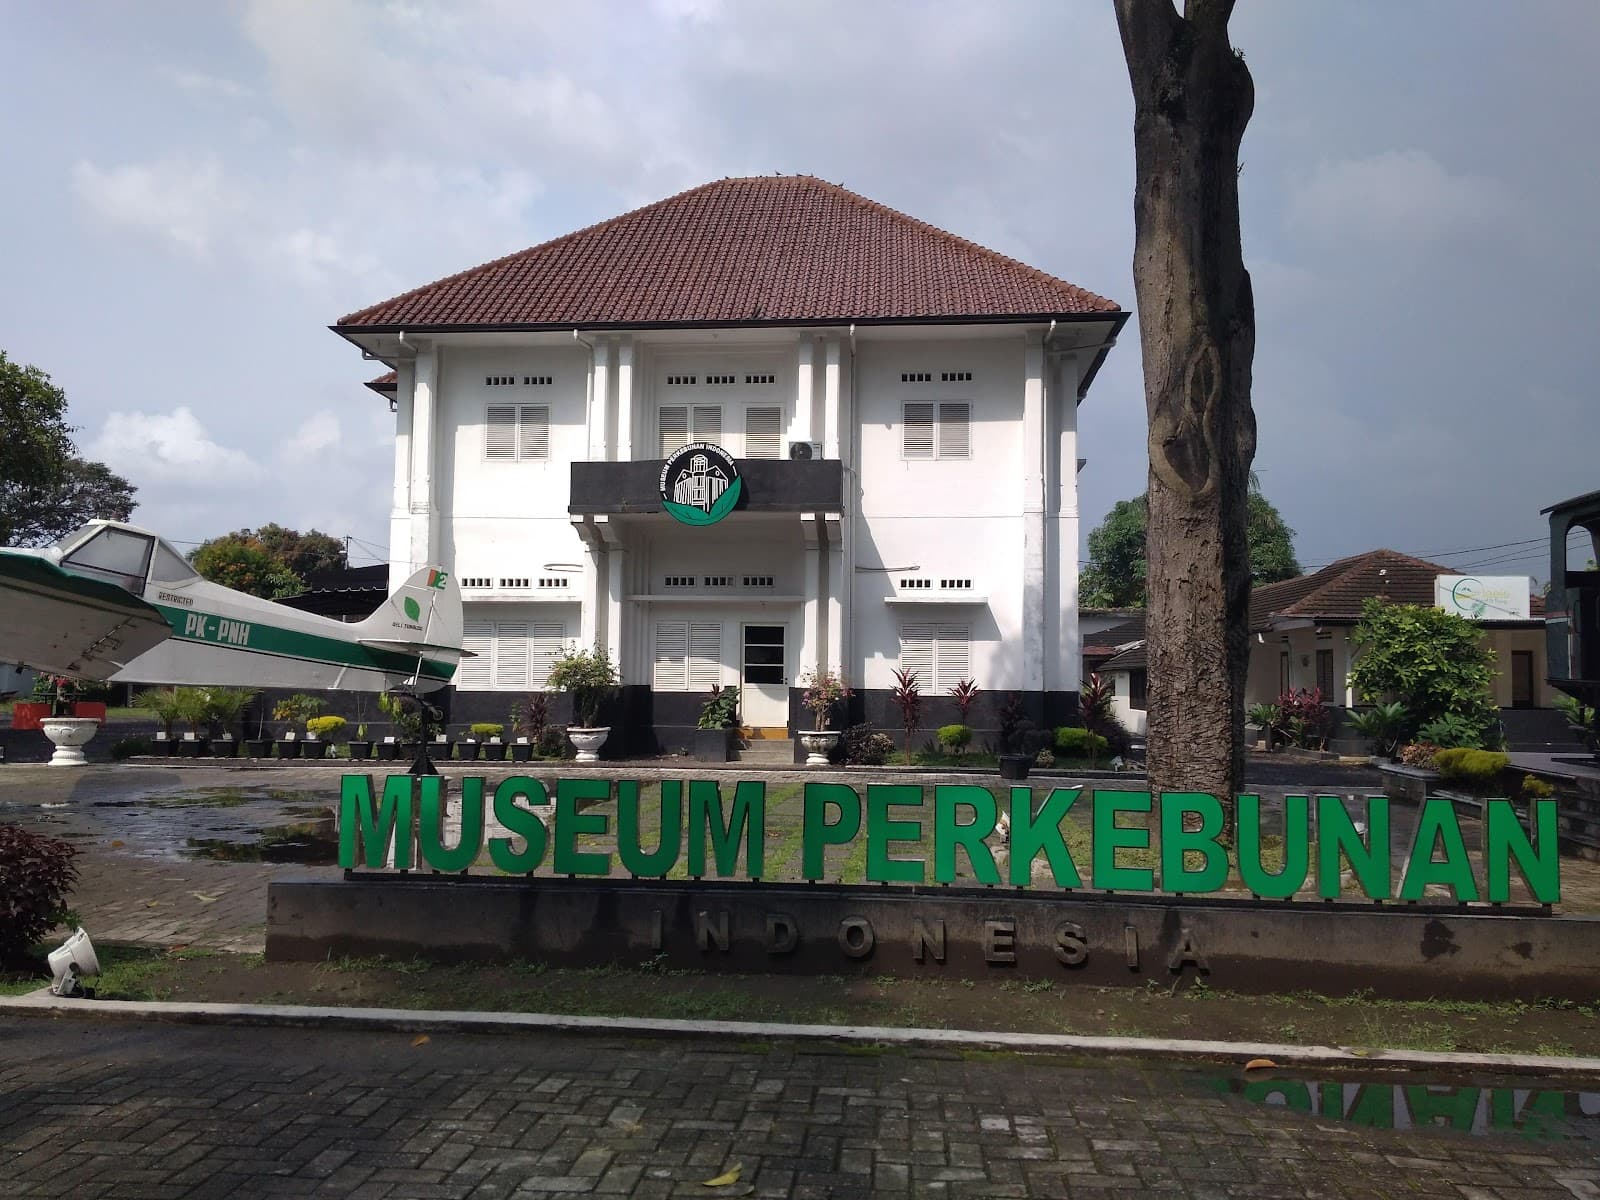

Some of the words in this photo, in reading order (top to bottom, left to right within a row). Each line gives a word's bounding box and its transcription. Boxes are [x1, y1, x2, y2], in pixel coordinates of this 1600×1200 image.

[660, 464, 671, 492] MUSEUM
[667, 443, 705, 466] PERKEBUNAN
[705, 444, 735, 467] INDONESIA
[158, 591, 194, 606] RESTRICTED
[338, 774, 766, 879] MUSEUM
[802, 781, 1561, 905] PERKEBUNAN
[650, 909, 1210, 974] INDONESIA
